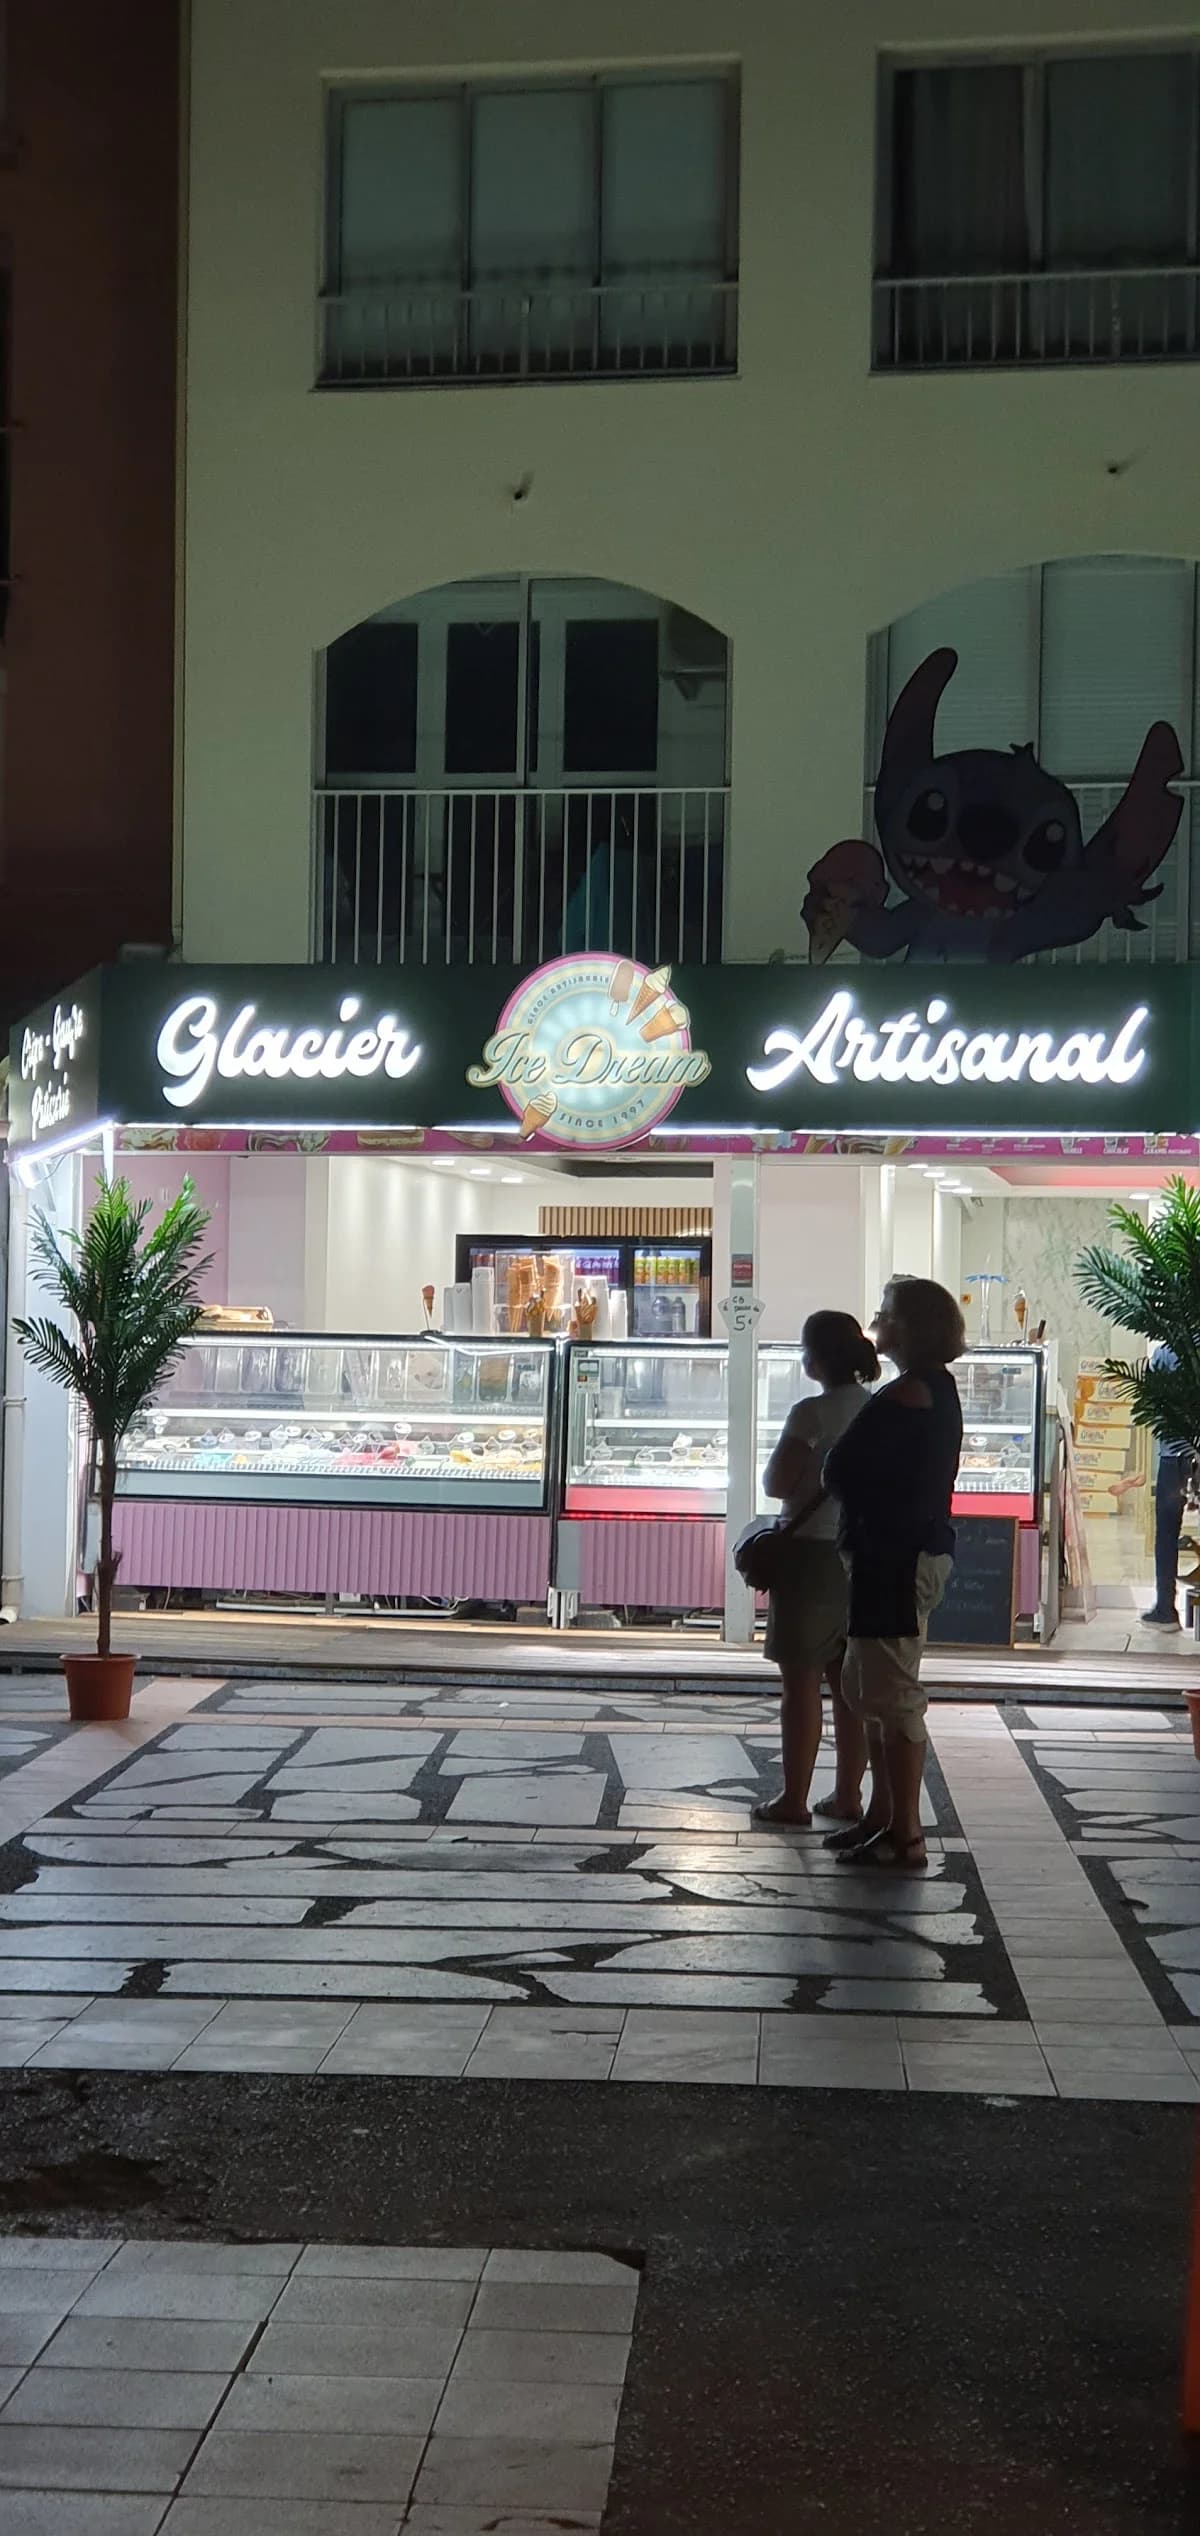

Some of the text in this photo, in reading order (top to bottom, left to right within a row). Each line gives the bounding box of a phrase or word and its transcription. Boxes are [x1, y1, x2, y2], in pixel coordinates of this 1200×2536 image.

[158, 991, 1148, 1106] Glacier Artisanal
[466, 1031, 711, 1087] Ice Dream
[613, 1098, 645, 1124] 1997
